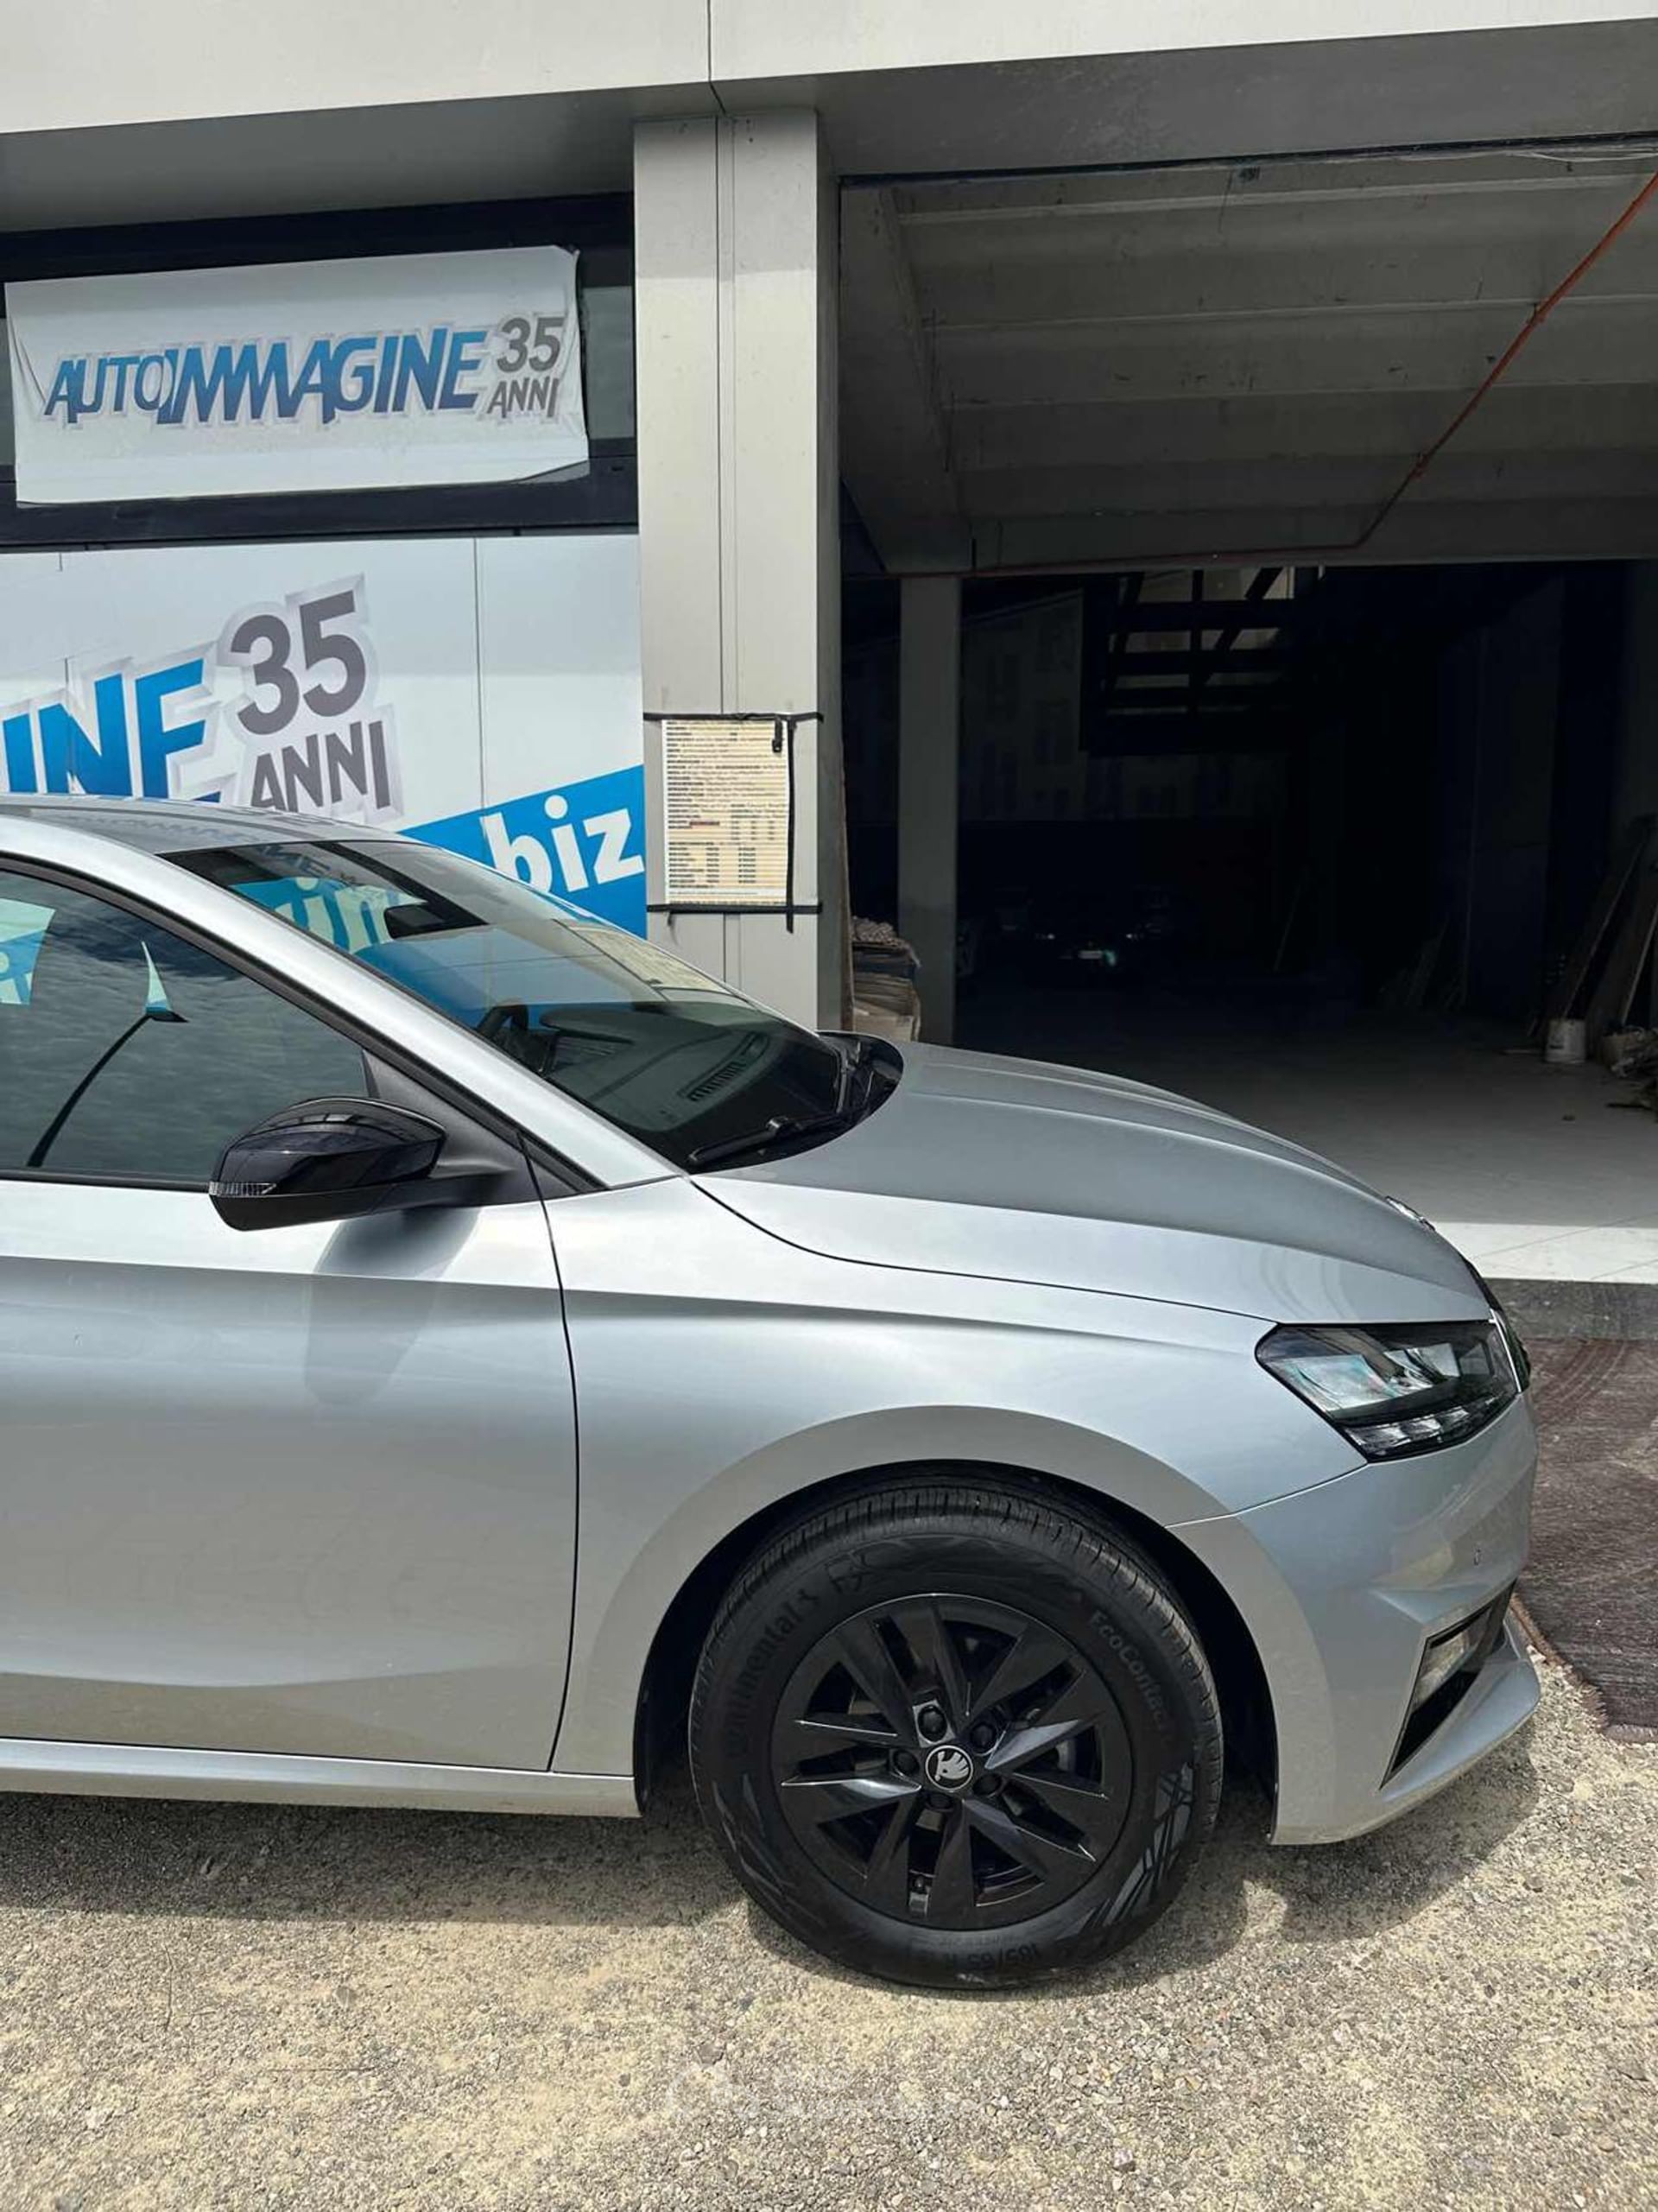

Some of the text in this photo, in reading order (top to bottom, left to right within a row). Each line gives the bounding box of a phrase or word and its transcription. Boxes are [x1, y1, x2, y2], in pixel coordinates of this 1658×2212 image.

[497, 316, 565, 372] 35
[486, 377, 560, 419] ANNI
[231, 590, 365, 735] 35
[250, 720, 390, 814] ANNI
[480, 795, 645, 892] biz
